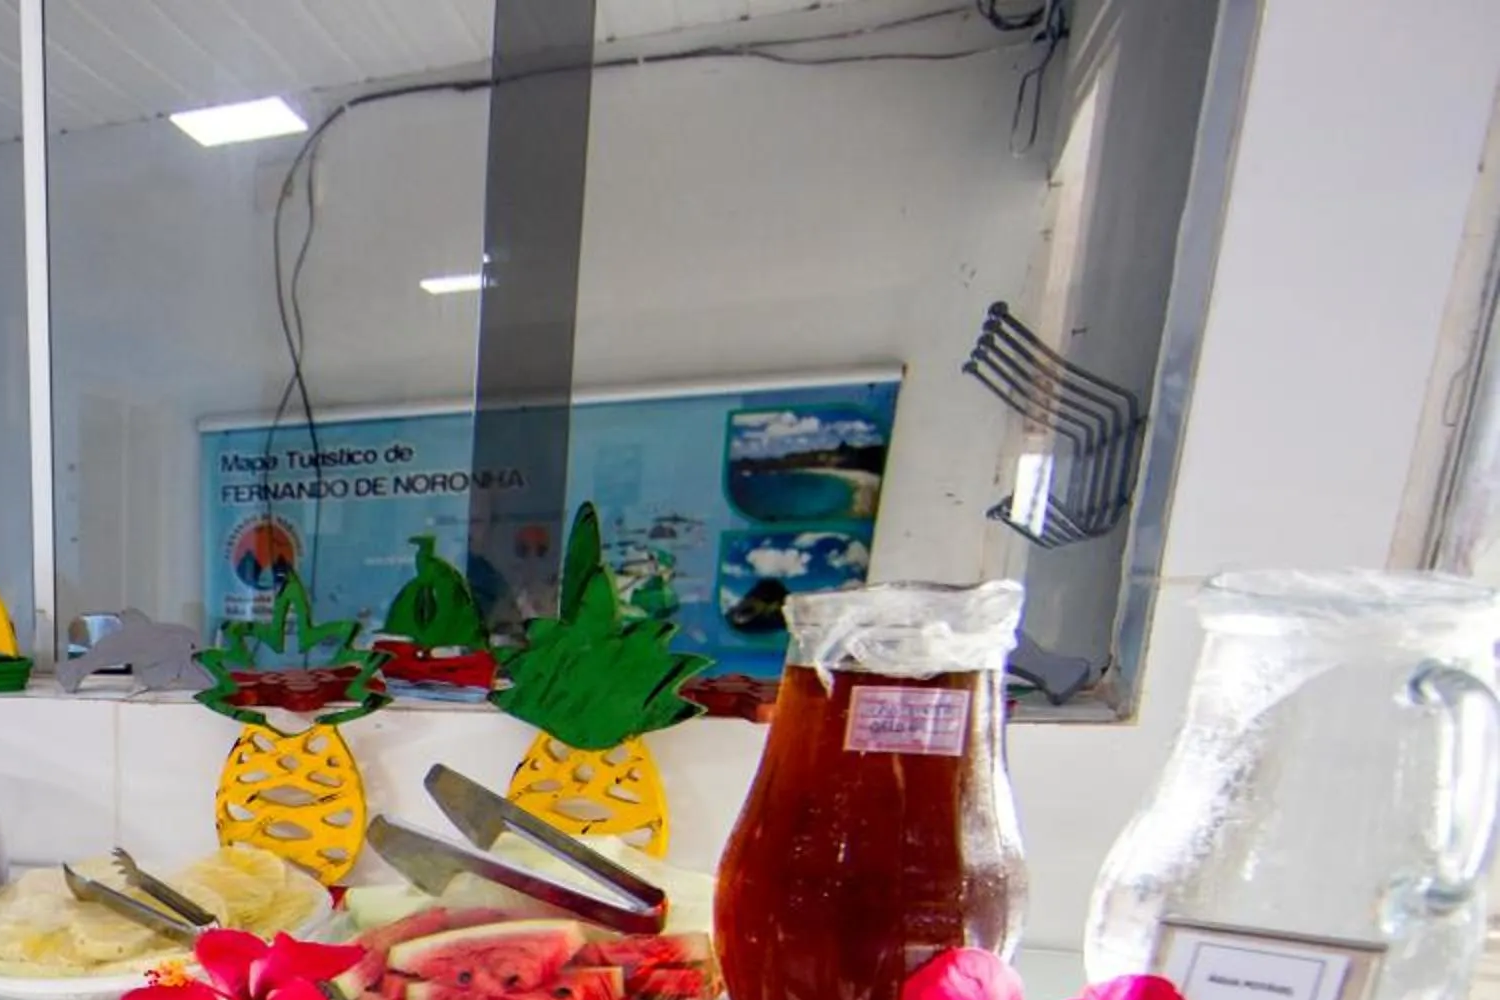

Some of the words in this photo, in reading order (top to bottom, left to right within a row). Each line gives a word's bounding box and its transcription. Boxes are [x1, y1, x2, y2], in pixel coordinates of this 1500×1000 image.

[220, 454, 278, 475] Mapa
[384, 444, 414, 463] de
[221, 479, 349, 503] FERNANDO
[355, 476, 388, 497] DE
[393, 468, 525, 494] NORONHA
